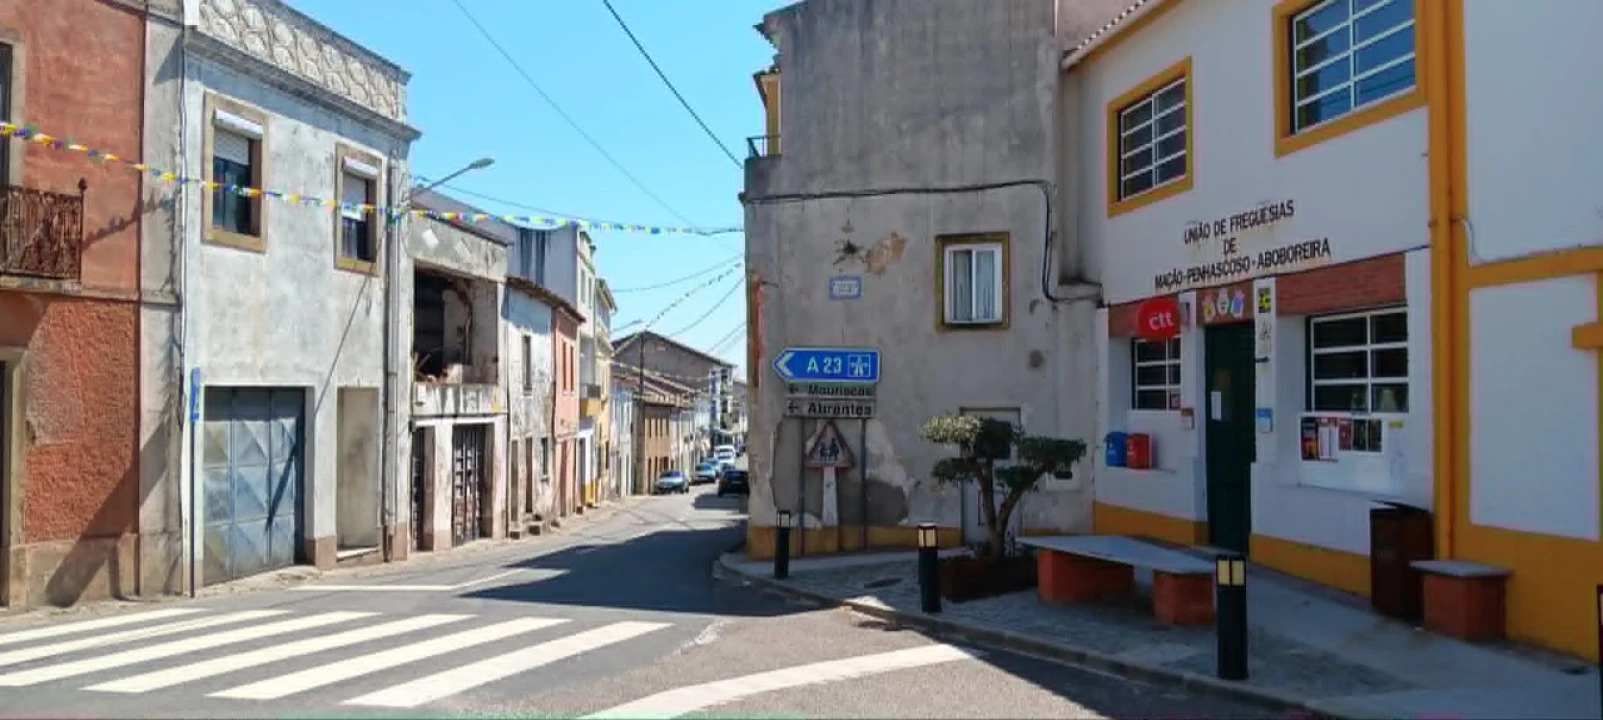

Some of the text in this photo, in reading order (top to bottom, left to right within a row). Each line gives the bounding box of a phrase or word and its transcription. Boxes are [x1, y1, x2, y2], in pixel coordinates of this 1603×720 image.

[1183, 200, 1295, 244] UNIÃO DE FREGUESIAS
[1223, 238, 1237, 255] DE
[1257, 237, 1331, 269] ABOBOREIRA
[1148, 311, 1175, 331] ctt
[807, 356, 842, 374] A 23
[808, 383, 874, 396] Mouriscas
[808, 402, 872, 416] Abrantes
